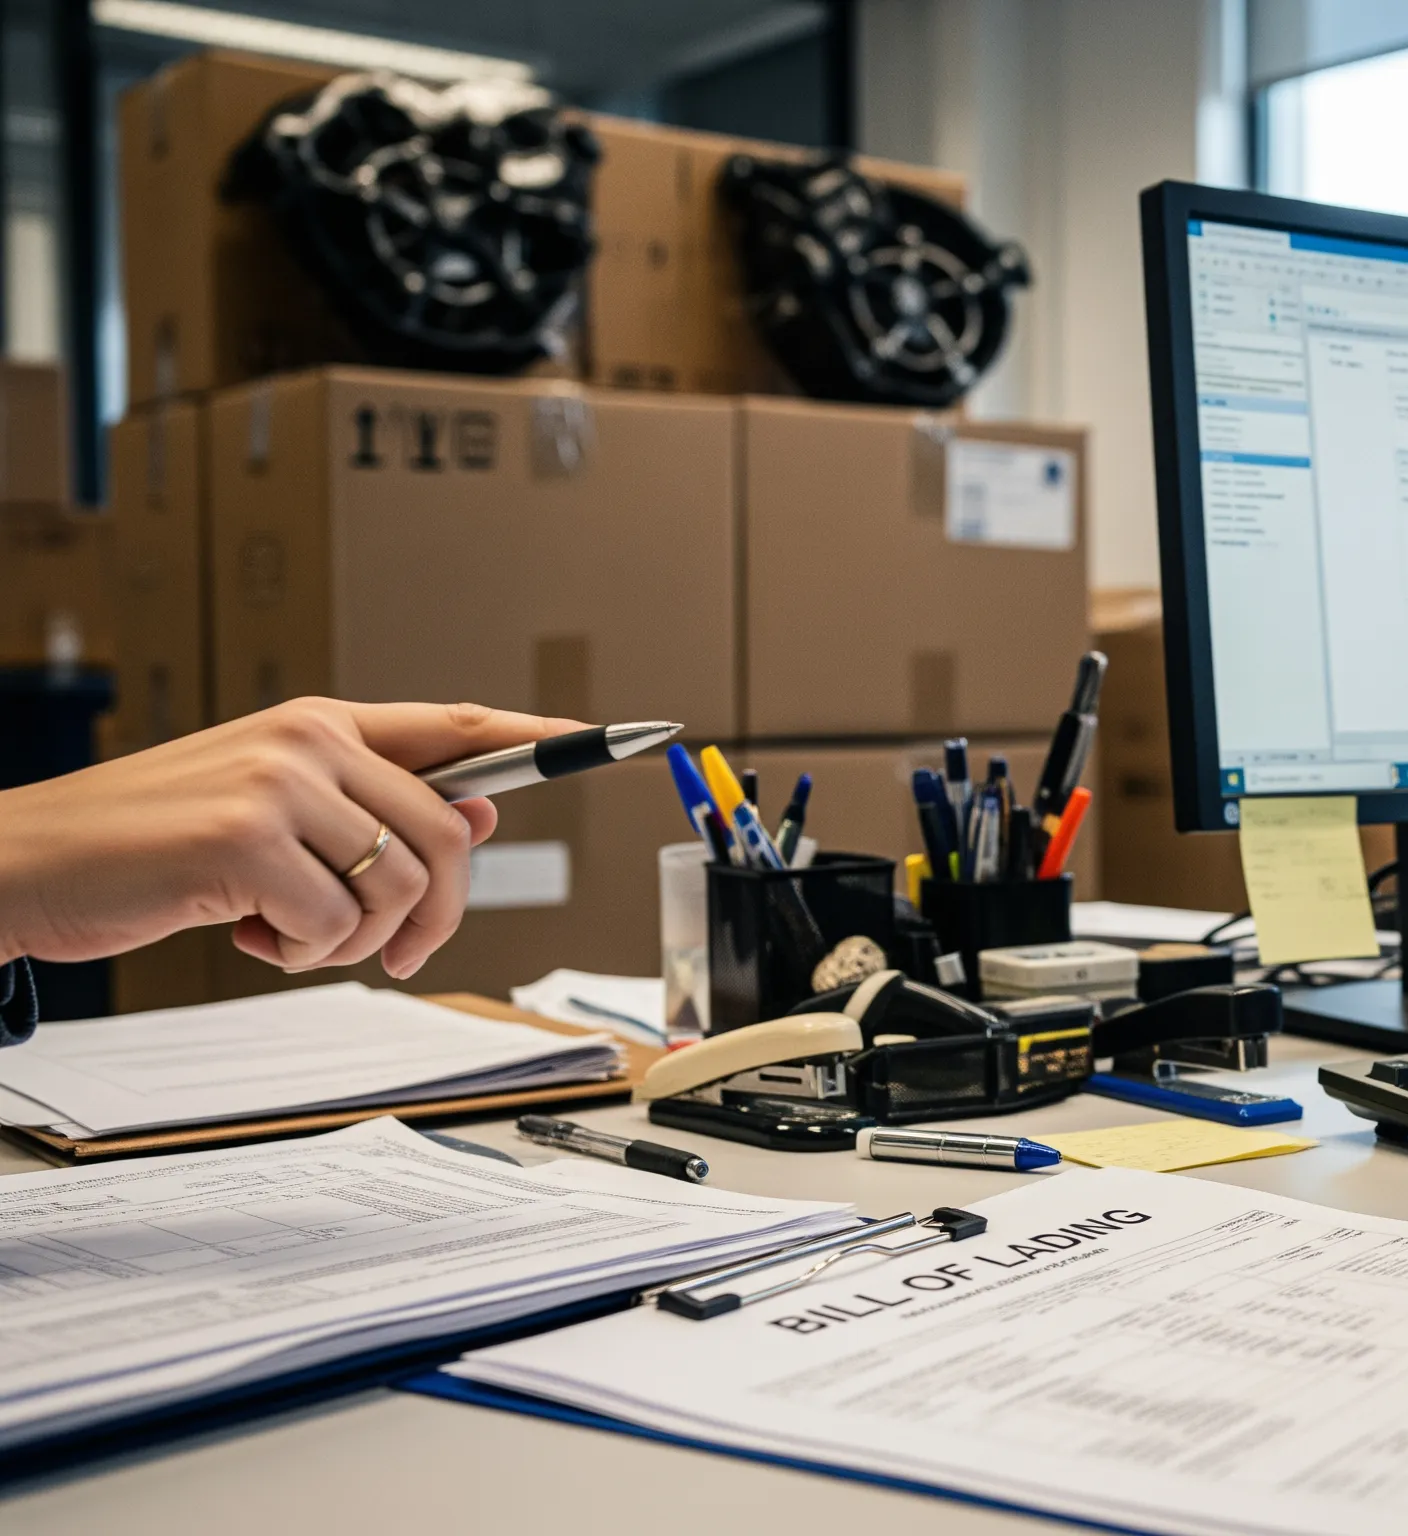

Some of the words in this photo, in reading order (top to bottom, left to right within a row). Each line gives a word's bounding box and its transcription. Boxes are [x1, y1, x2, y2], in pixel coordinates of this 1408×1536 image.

[770, 1293, 913, 1334] BILL
[902, 1262, 972, 1291] OF
[974, 1209, 1152, 1268] LADING
